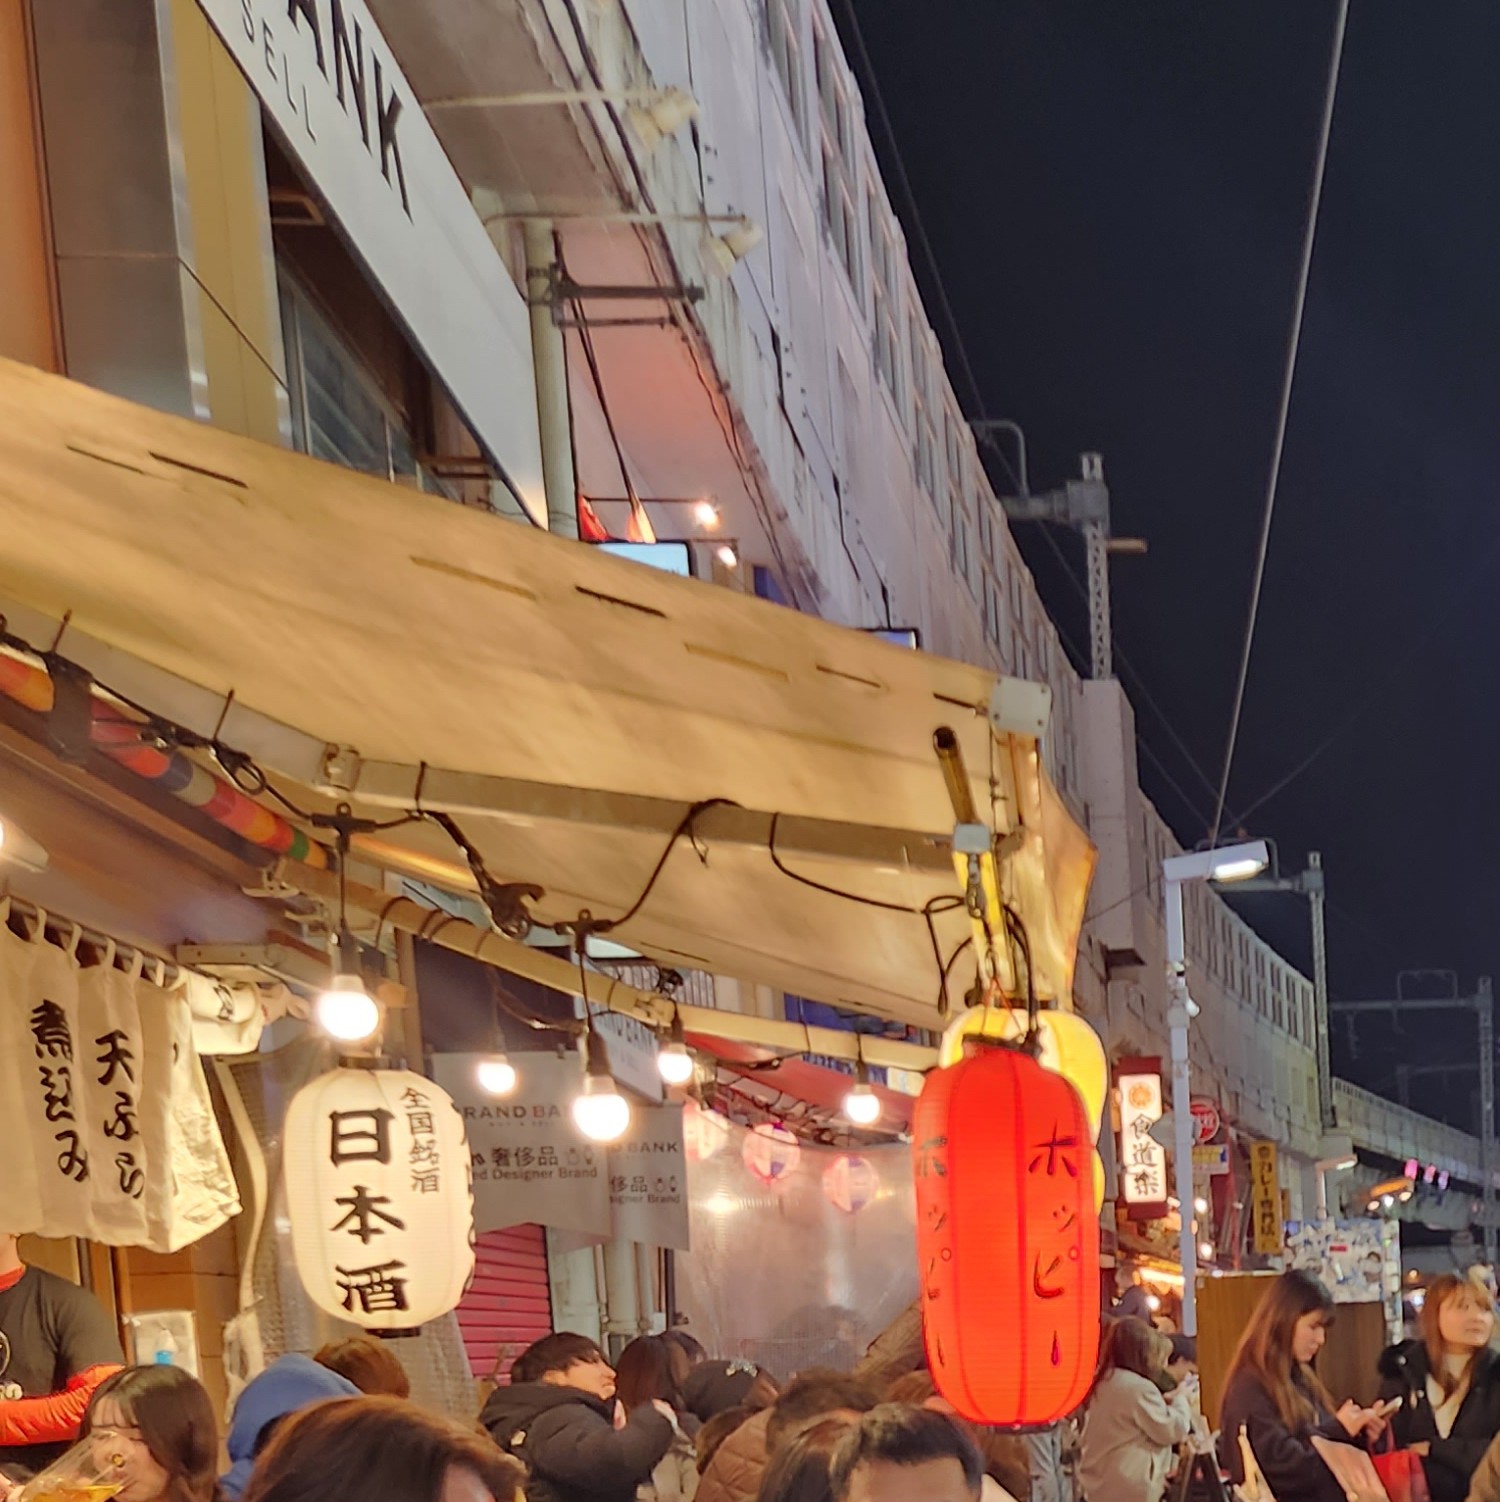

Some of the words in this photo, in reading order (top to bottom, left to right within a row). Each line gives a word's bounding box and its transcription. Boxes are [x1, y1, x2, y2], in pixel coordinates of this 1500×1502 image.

[491, 1145, 558, 1166] 奢侈品
[492, 1168, 553, 1182] Designer
[558, 1166, 598, 1179] Brand
[1130, 1113, 1160, 1197] 食道楽
[329, 1106, 410, 1315] 日本酒
[1028, 1119, 1080, 1367] ホッピー
